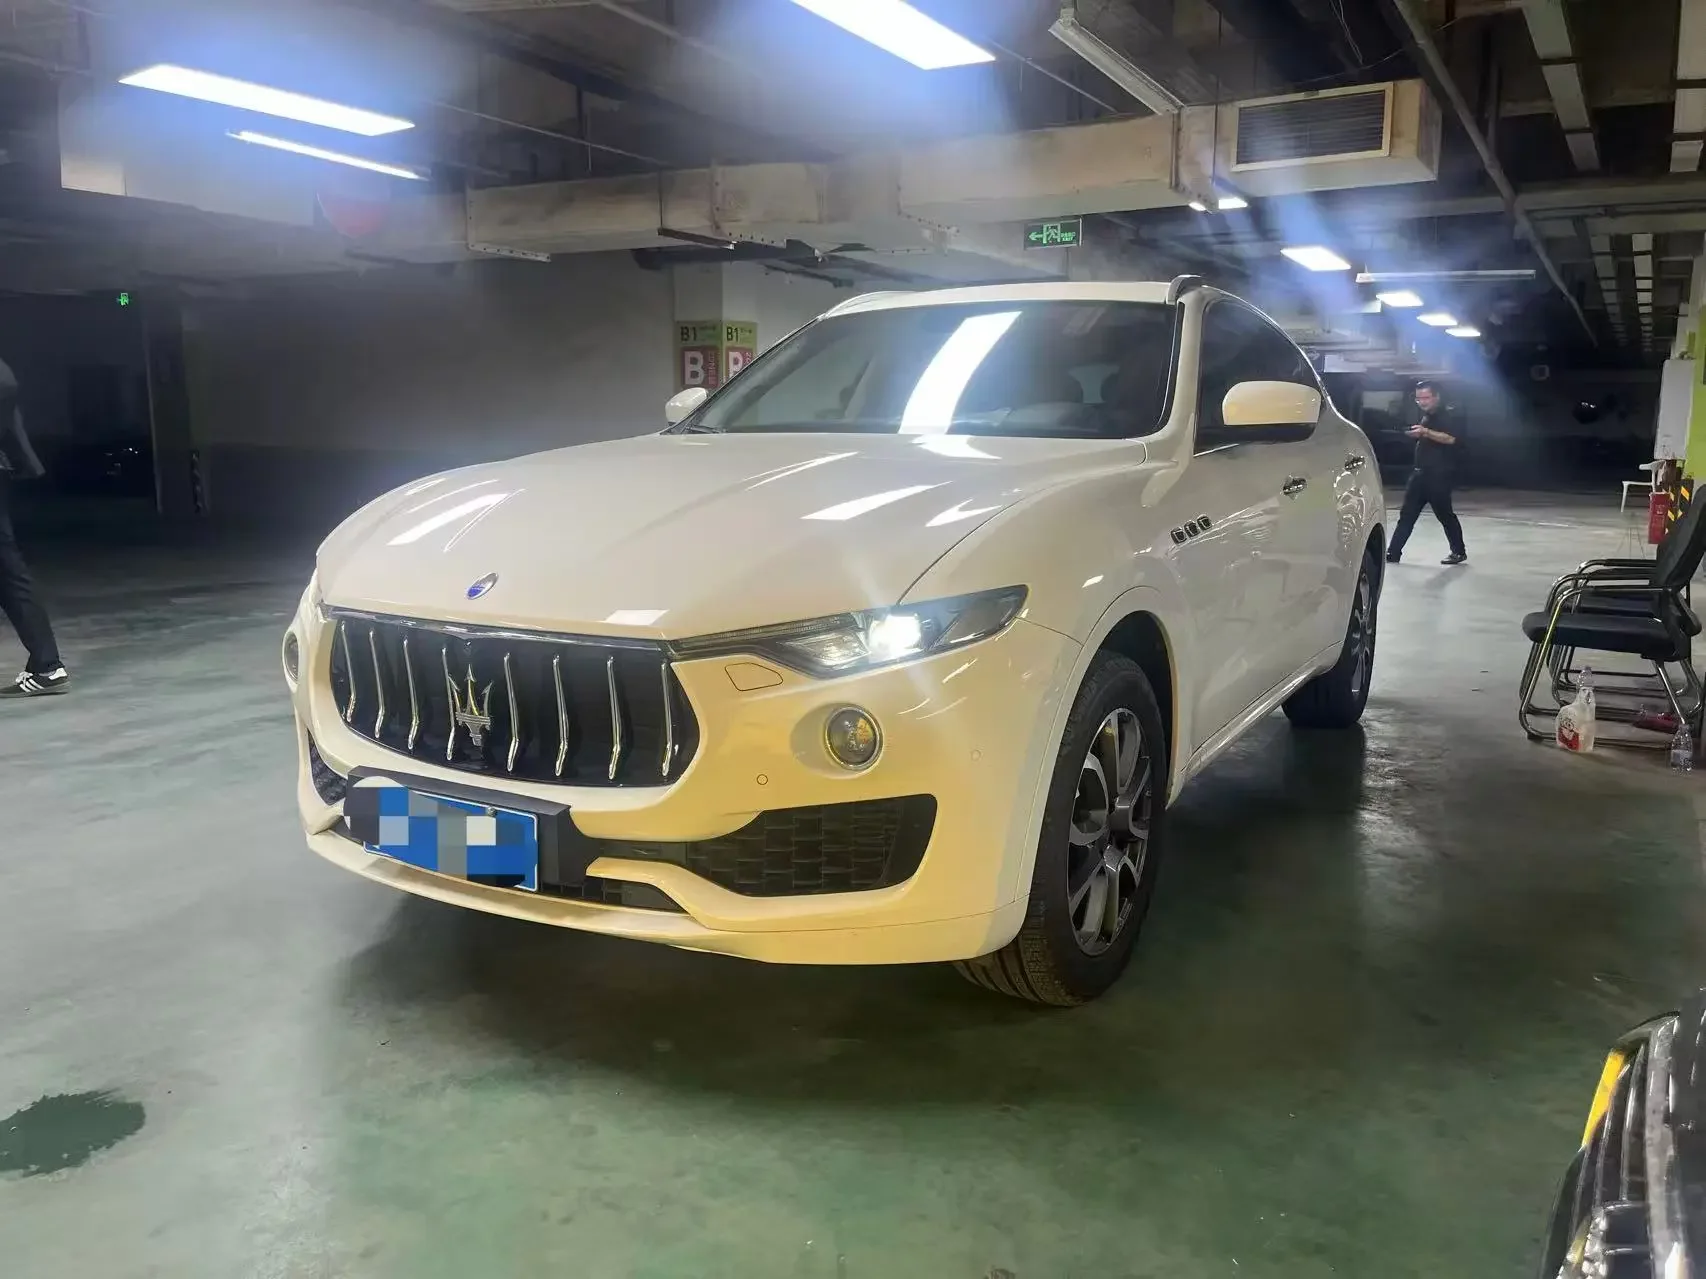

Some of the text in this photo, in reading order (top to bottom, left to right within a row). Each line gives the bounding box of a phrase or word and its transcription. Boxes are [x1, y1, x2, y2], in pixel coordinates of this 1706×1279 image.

[680, 326, 697, 341] B1
[726, 326, 739, 342] B1
[684, 351, 704, 385] B
